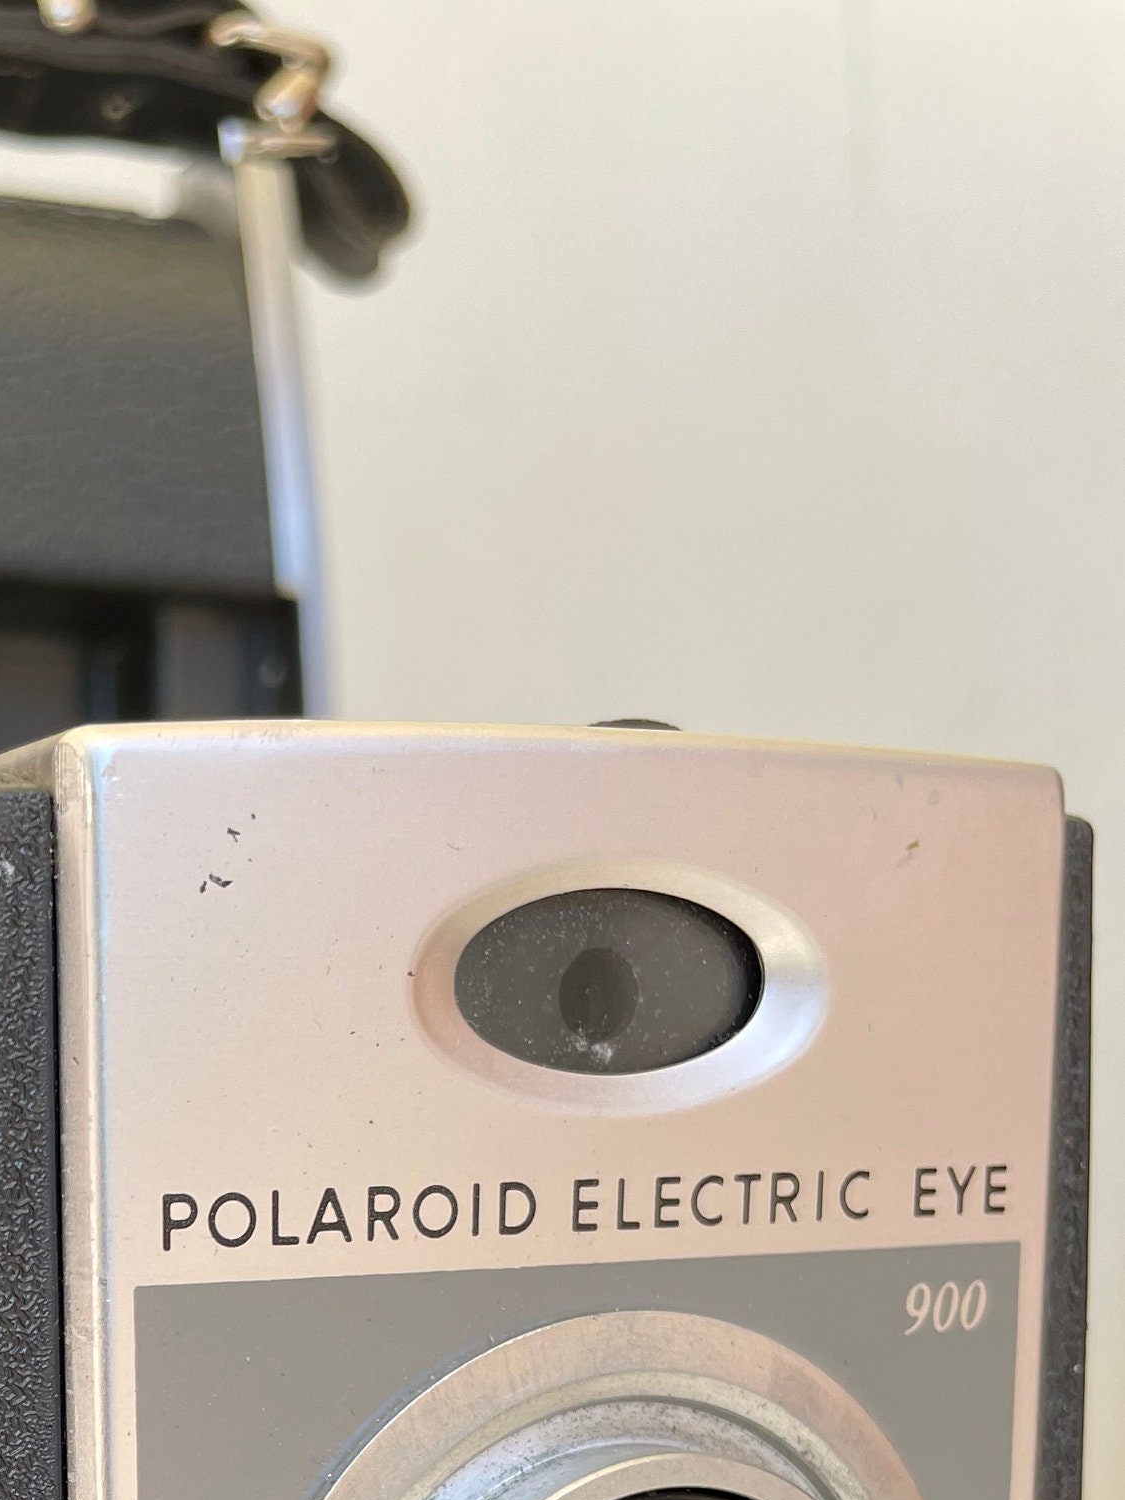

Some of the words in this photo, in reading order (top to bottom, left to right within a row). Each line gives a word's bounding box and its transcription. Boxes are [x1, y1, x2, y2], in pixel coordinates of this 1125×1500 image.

[162, 1181, 537, 1252] POLAROID
[572, 1168, 871, 1232] ELECTRIC
[913, 1164, 1009, 1218] EYE
[905, 1280, 988, 1336] 900
